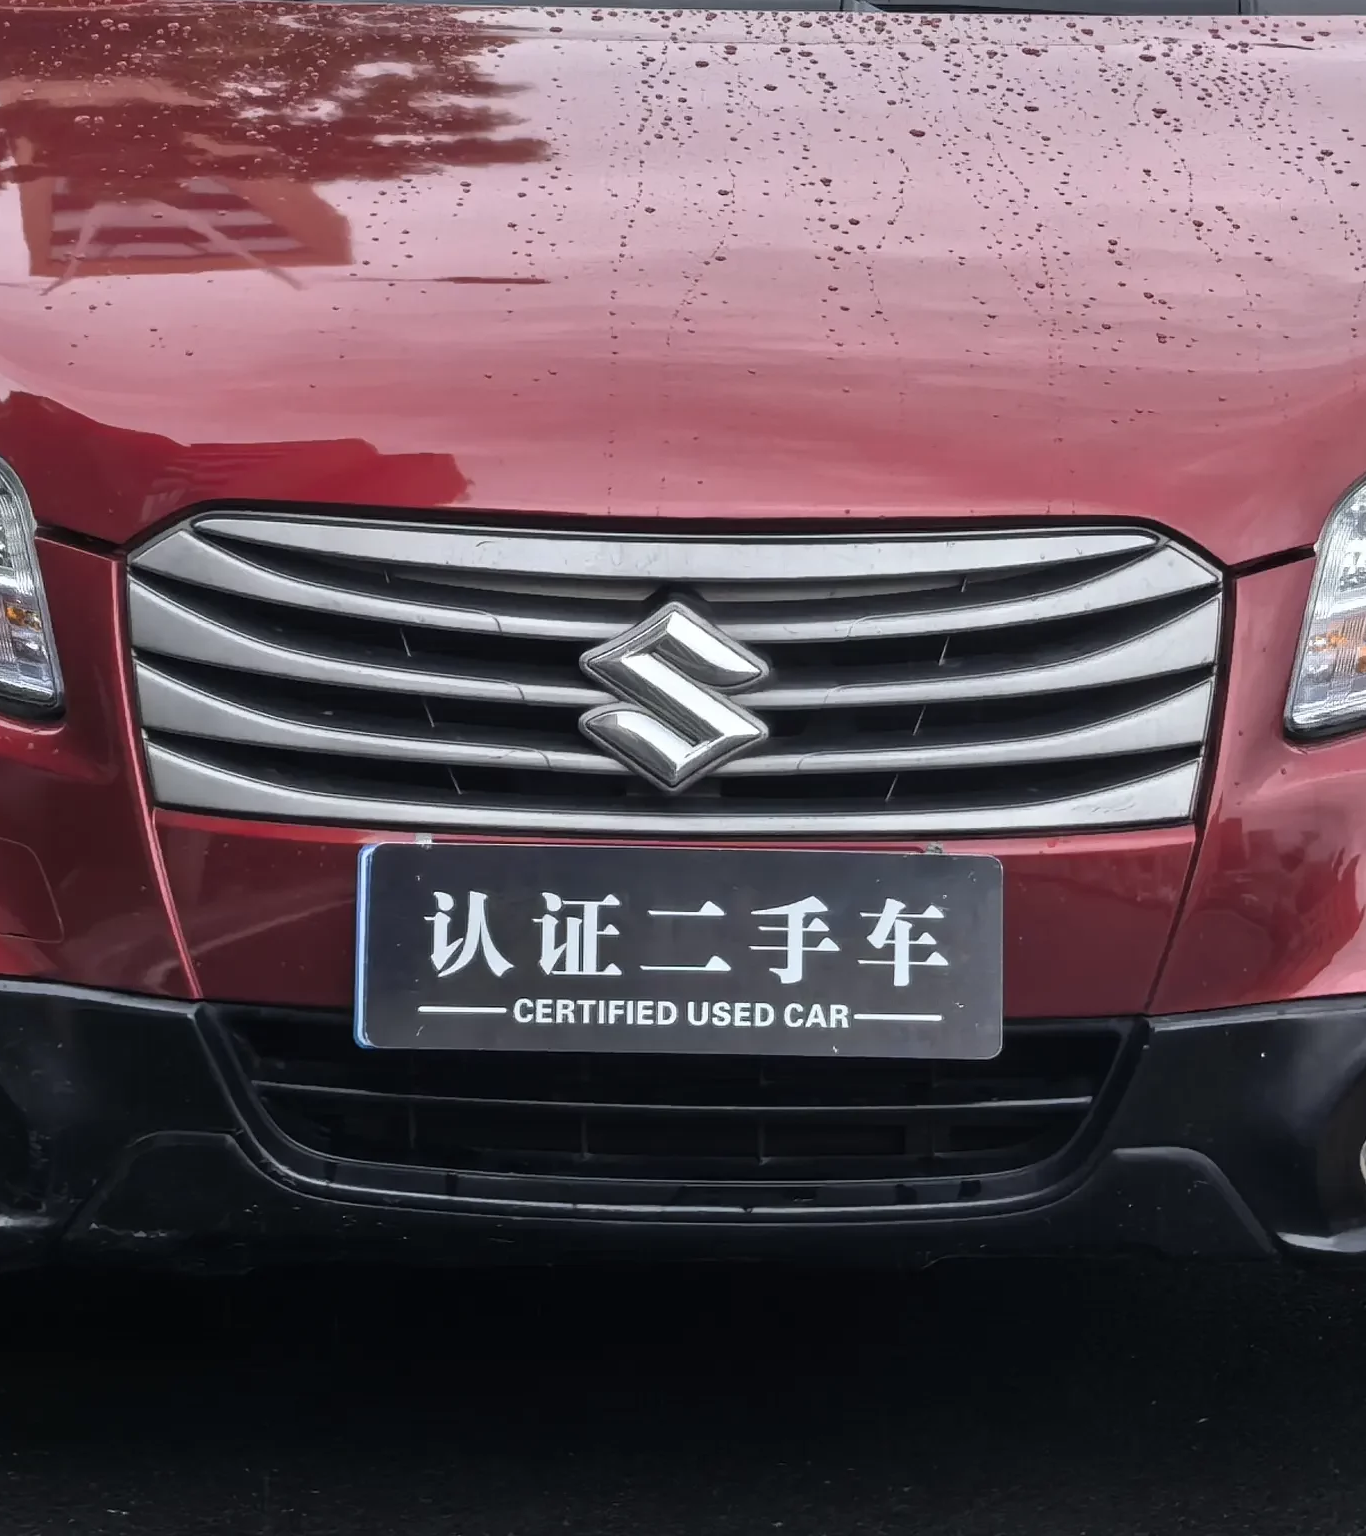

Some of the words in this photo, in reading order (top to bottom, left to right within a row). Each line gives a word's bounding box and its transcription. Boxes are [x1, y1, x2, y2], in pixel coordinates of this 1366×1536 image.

[424, 890, 950, 987] 认证二手车
[513, 997, 678, 1026] CERTIFIED
[686, 1002, 774, 1028] USED
[783, 1003, 850, 1030] CAR
